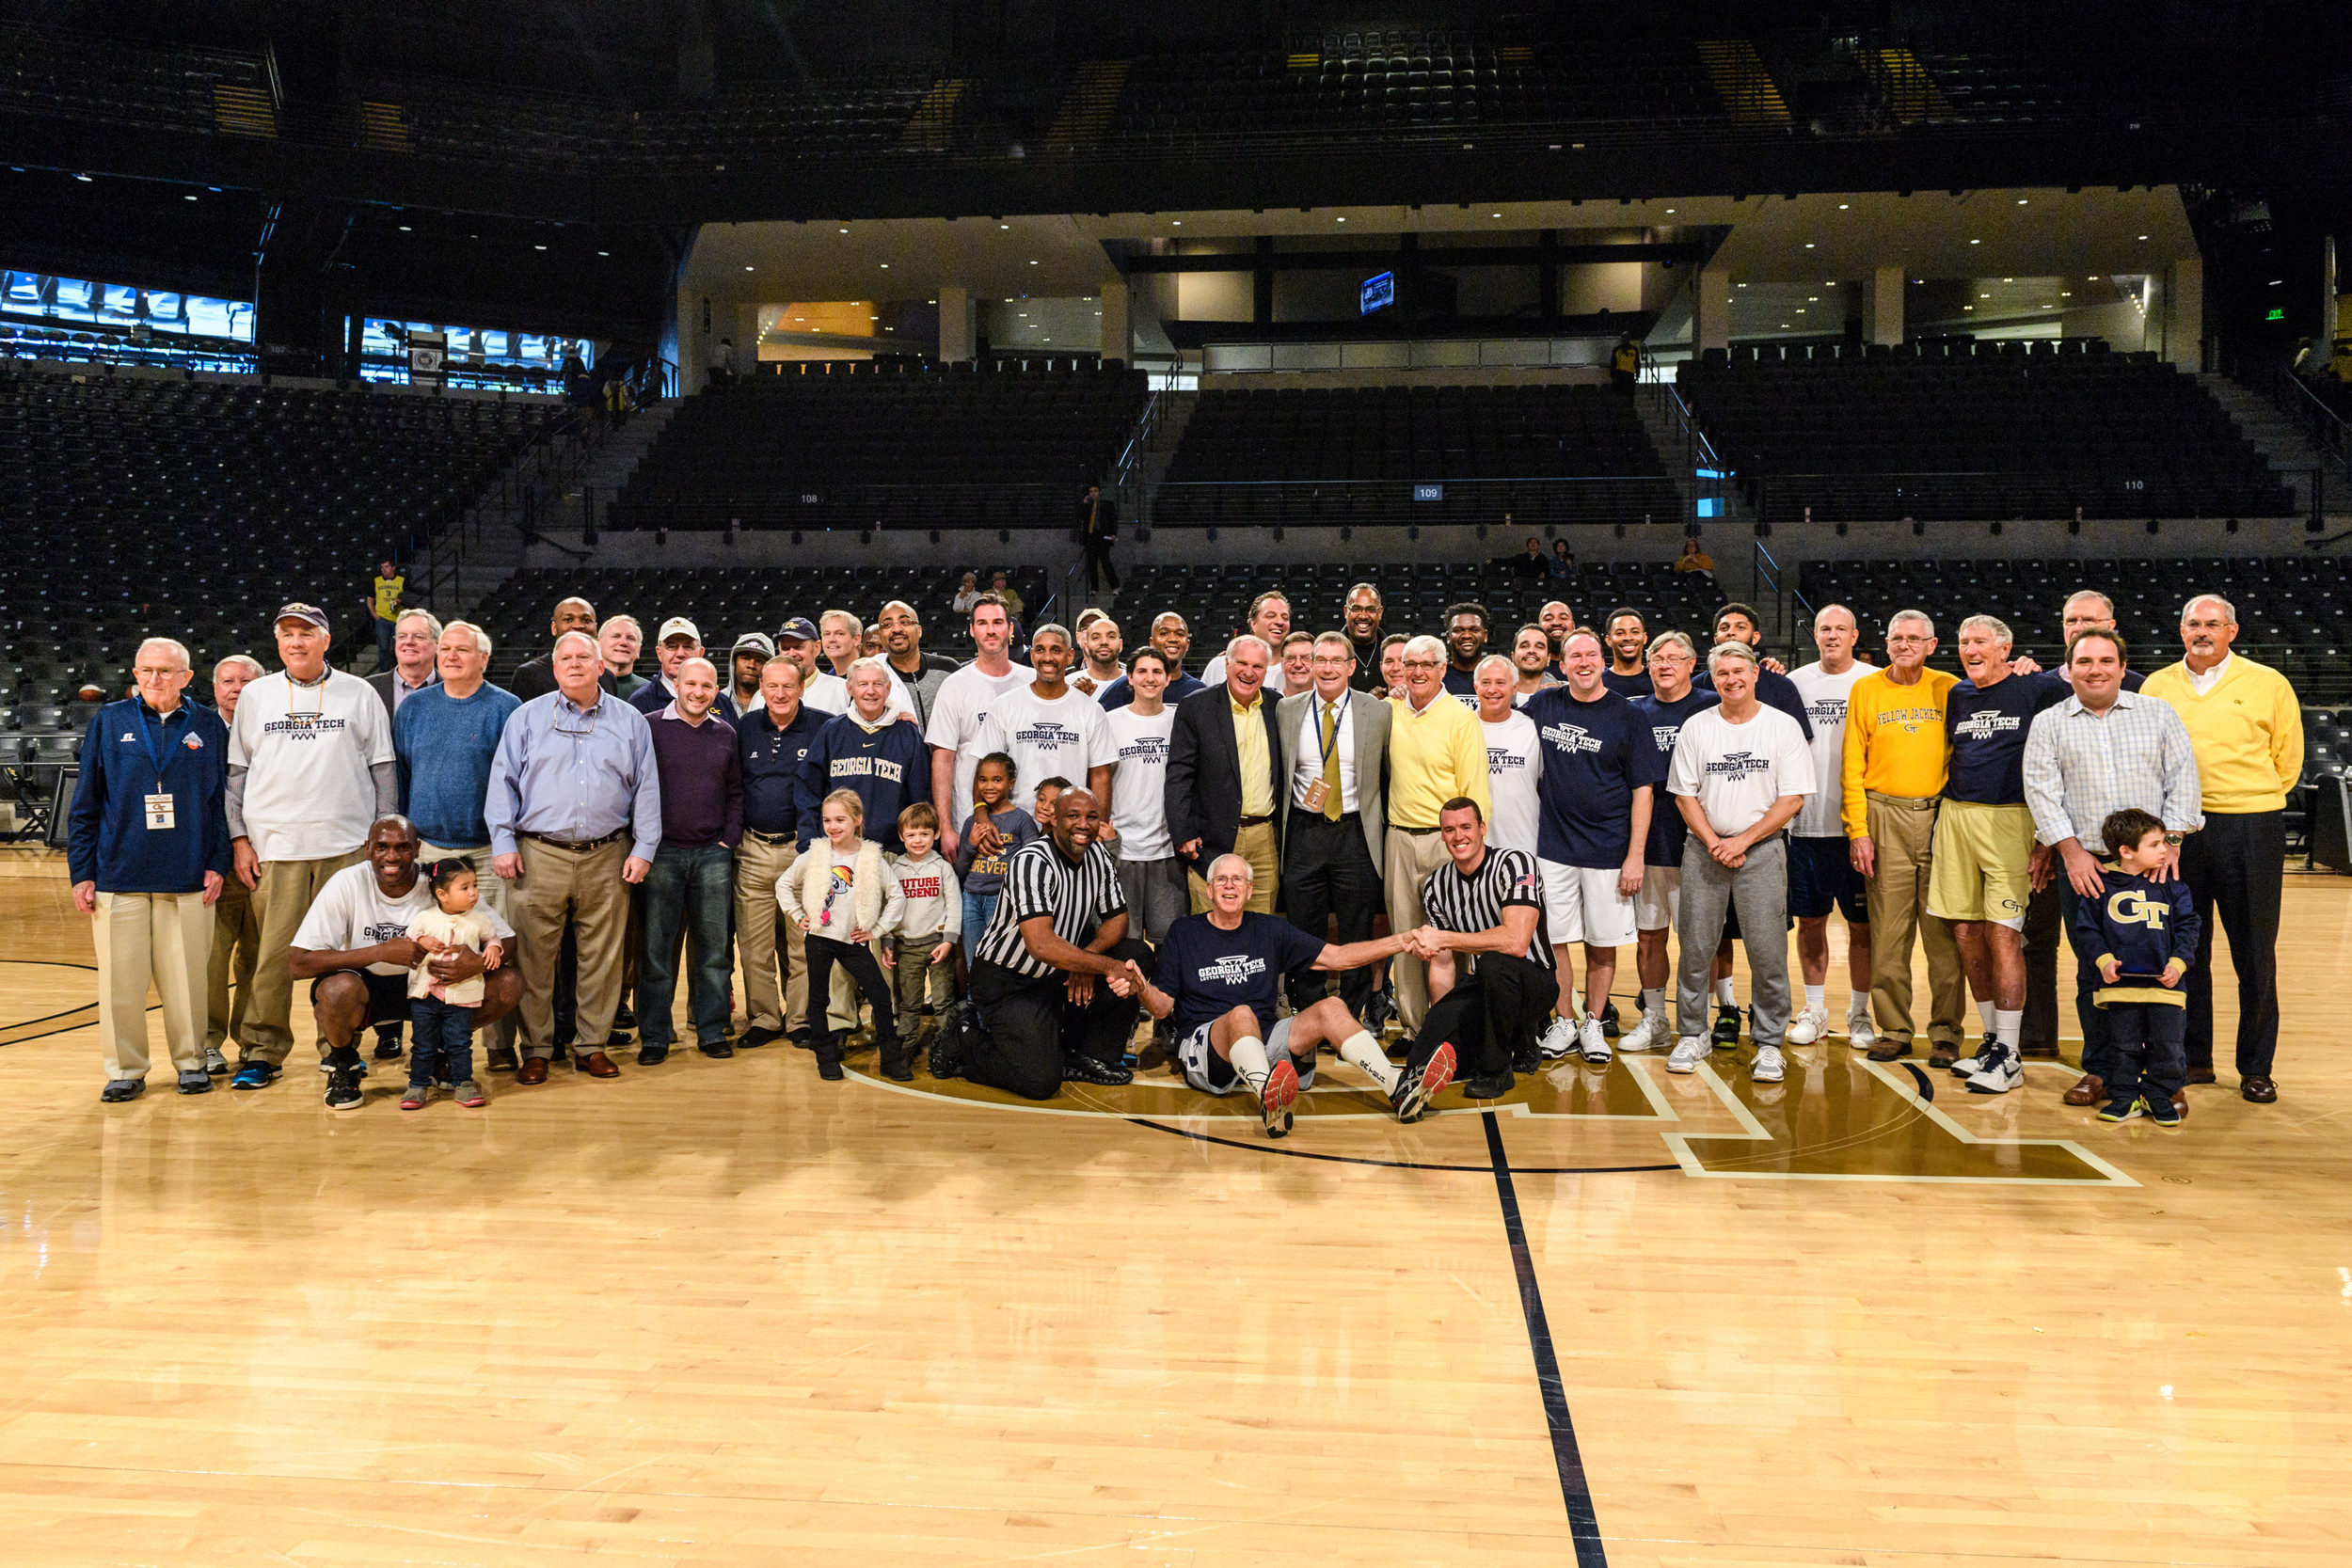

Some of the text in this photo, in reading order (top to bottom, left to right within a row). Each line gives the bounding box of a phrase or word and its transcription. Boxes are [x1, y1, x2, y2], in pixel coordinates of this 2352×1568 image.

[2124, 481, 2144, 490] 110
[801, 494, 818, 503] 108
[1420, 488, 1438, 498] 109
[1877, 707, 1943, 725] YELLOW JACKETS
[264, 719, 345, 732] GEORGIA TECH
[1903, 723, 1918, 734] GT
[1956, 716, 2021, 731] GEORGIA TECH
[1016, 730, 1080, 742] GEORGIA TECH
[1541, 725, 1603, 750] GEORGIA TECH
[1119, 744, 1170, 757] GEORGIA TE
[1501, 755, 1526, 766] TECH
[1743, 759, 1770, 769] TECH
[830, 756, 902, 784] GEORGIA TECH
[903, 887, 940, 899] EGEND
[2002, 899, 2023, 913] GT
[2107, 890, 2170, 930] GT
[1198, 958, 1265, 977] GEORGIA TECH
